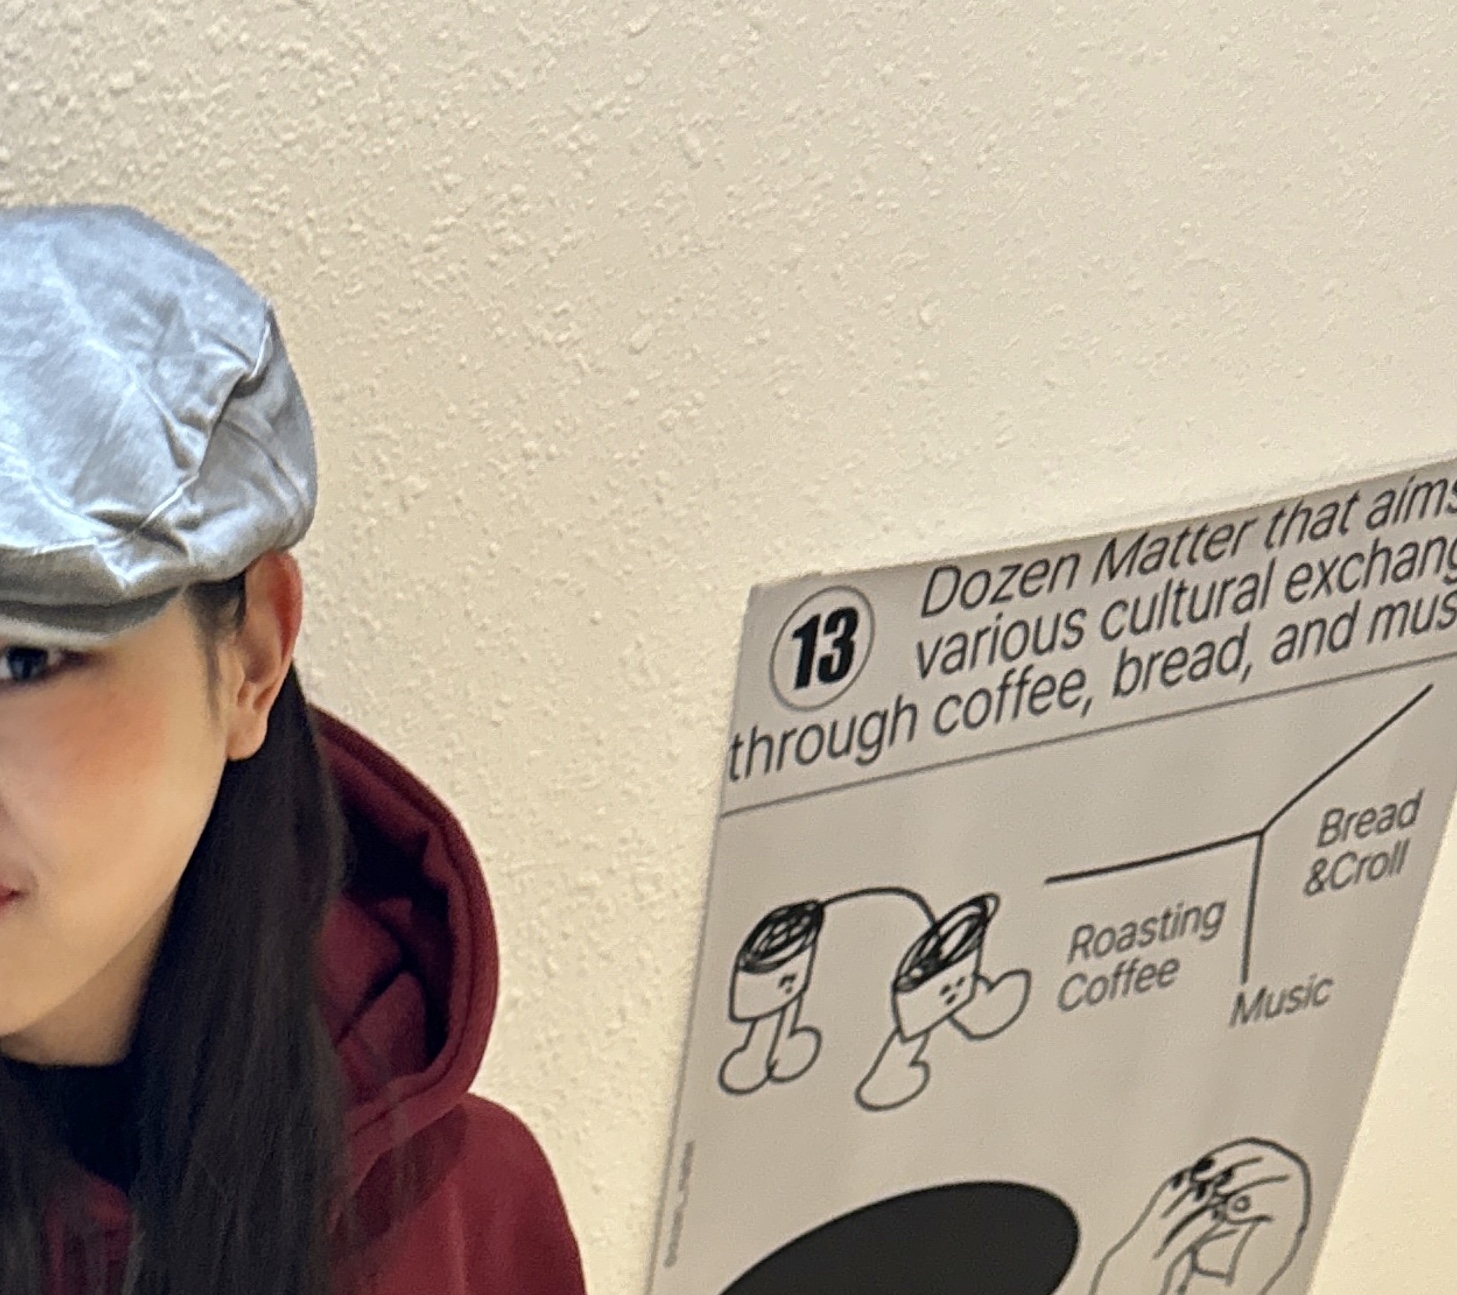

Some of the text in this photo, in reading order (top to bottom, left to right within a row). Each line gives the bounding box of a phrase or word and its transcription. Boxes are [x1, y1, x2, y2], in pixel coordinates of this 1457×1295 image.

[920, 551, 1081, 619] Dozen
[1091, 517, 1259, 586] Matter
[1264, 490, 1360, 550] that
[791, 606, 859, 691] 13
[916, 607, 1087, 680] various
[1100, 556, 1277, 642] cultural
[728, 693, 919, 783] through
[933, 663, 1093, 735] coffee,
[1111, 621, 1253, 699] bread,
[1271, 598, 1361, 665] and
[1315, 788, 1424, 848] Bread
[1302, 838, 1410, 898] &Croll
[1066, 900, 1227, 965] Roasting
[1056, 956, 1181, 1014] Coffee
[1228, 973, 1335, 1029] Music
